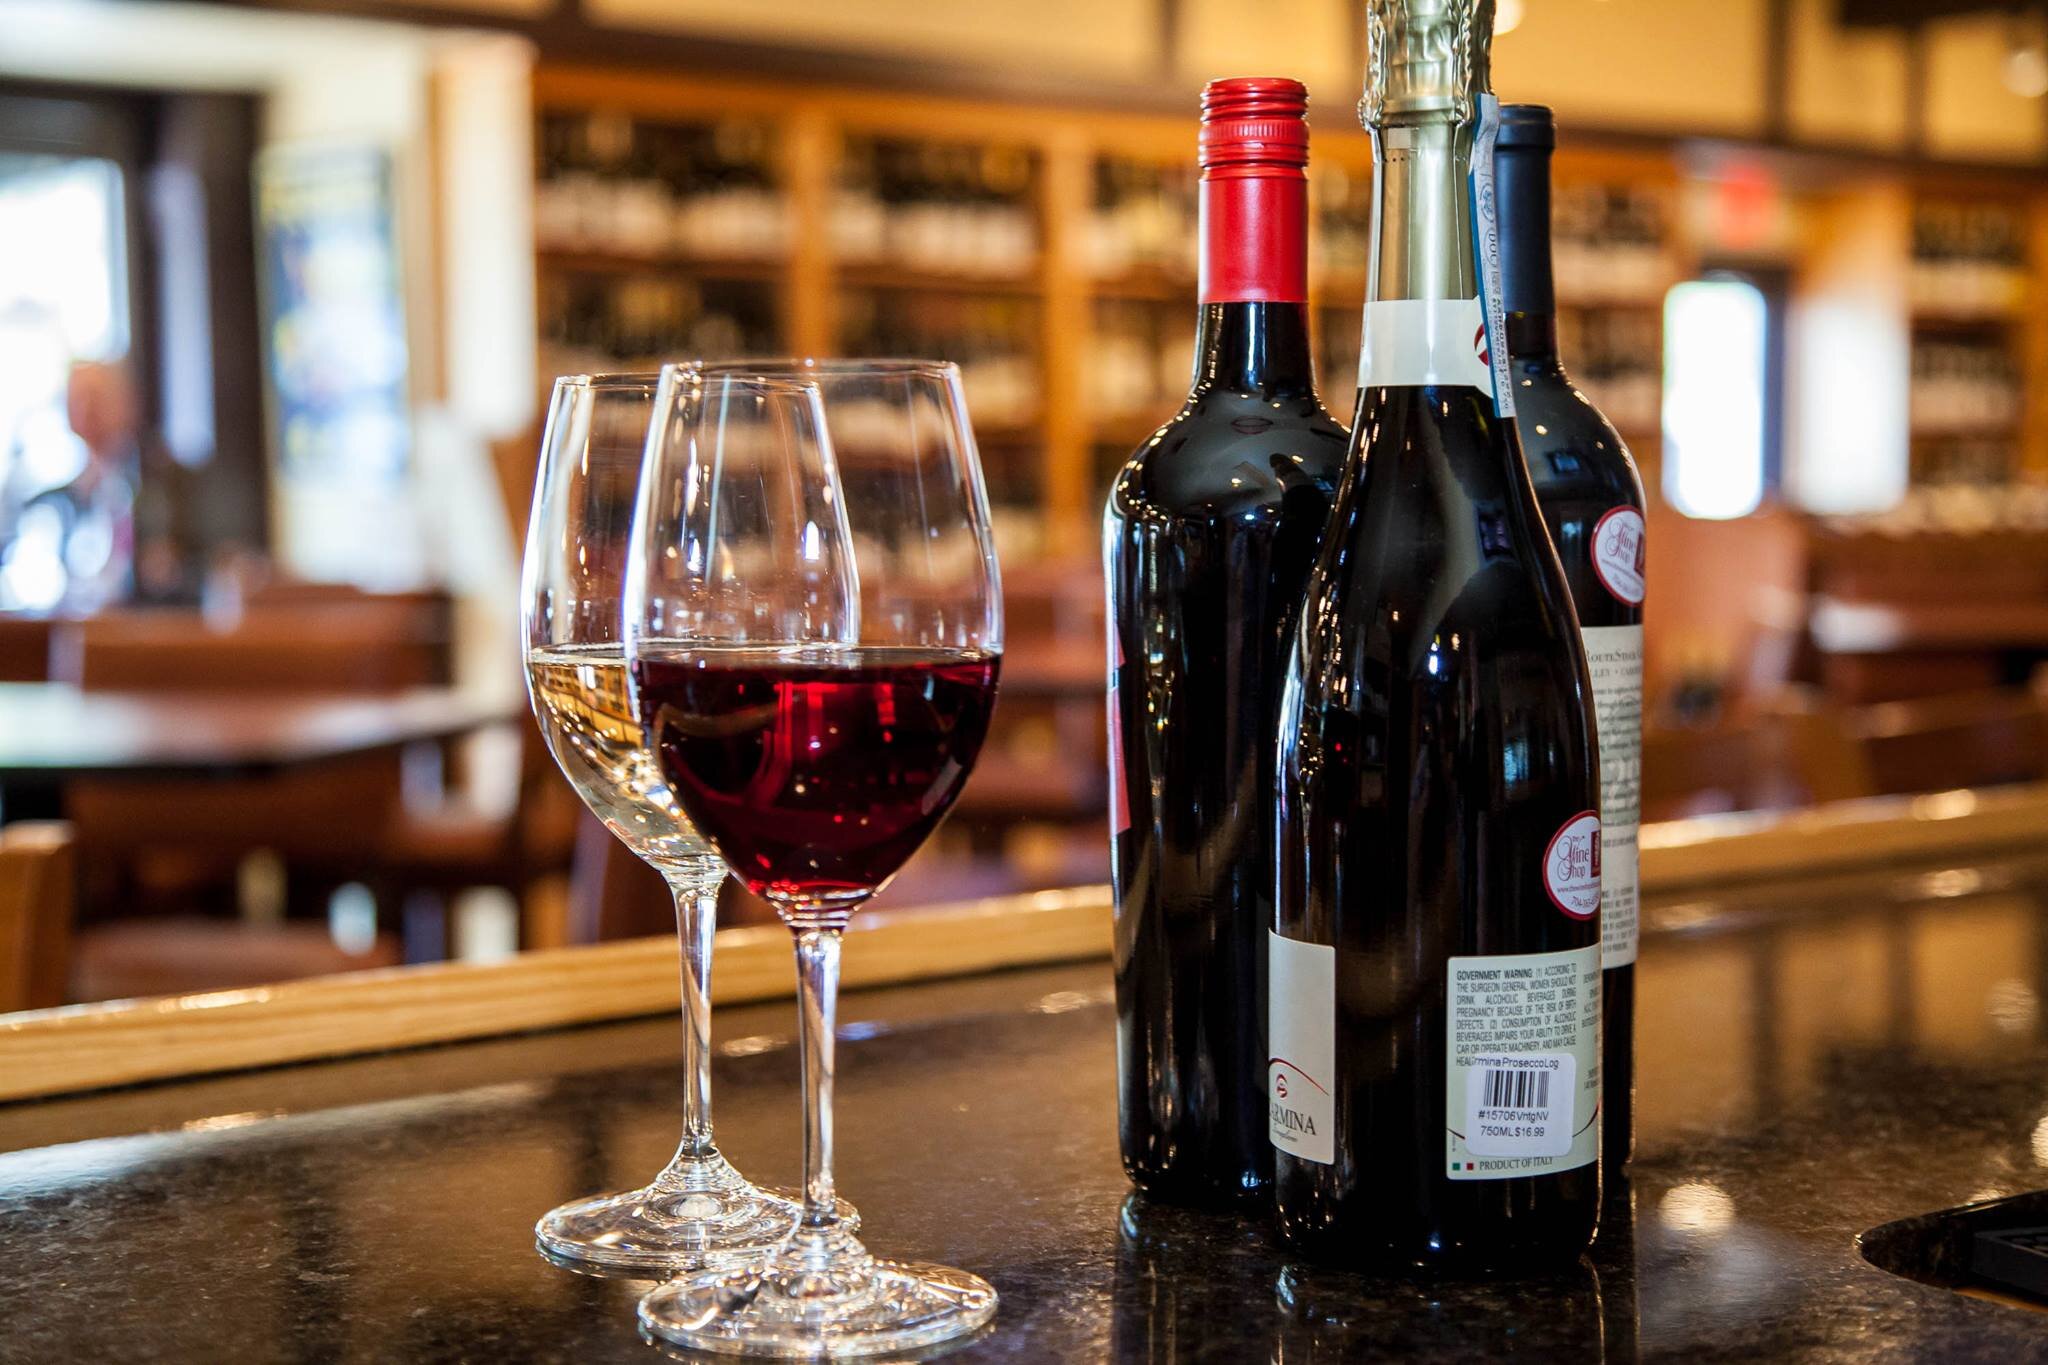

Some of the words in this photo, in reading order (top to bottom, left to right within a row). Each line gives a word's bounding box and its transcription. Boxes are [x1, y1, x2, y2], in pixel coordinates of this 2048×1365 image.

[1457, 970, 1501, 981] GOVERNMENT
[1544, 964, 1570, 976] ACCORDING
[1456, 982, 1468, 993] THE
[1470, 981, 1500, 993] SURGEON
[1530, 978, 1550, 990] WOMEN
[1550, 976, 1568, 987] SHOULD
[1456, 995, 1475, 1006] DRINK
[1486, 994, 1518, 1005] ALCOHOLIC
[1527, 990, 1556, 1003] BEVERAGES
[1456, 1006, 1494, 1018] PREGNANCY
[1497, 1005, 1523, 1016] BECAUSE
[1526, 1004, 1532, 1015] OF
[1535, 1003, 1544, 1014] THE
[1546, 1002, 1556, 1012] RISK
[1502, 1016, 1542, 1029] CONSUMPTION
[1545, 1015, 1552, 1026] OF
[1456, 1031, 1493, 1042] BEVERAGES
[1494, 1030, 1518, 1042] IMPAIRS
[1520, 1029, 1534, 1040] YOUR
[1536, 1026, 1553, 1038] ABILITY
[1554, 1026, 1560, 1036] TO
[1561, 1024, 1572, 1036] DRIVE
[1456, 1043, 1470, 1054] CAR
[1470, 1043, 1480, 1054] OR
[1480, 1042, 1508, 1054] OPERATE
[1542, 1039, 1552, 1050] AND
[1553, 1038, 1562, 1049] MAY
[1480, 1159, 1520, 1171] PRODUCT
[1521, 1158, 1532, 1169] OF
[1532, 1156, 1554, 1167] ITALY
